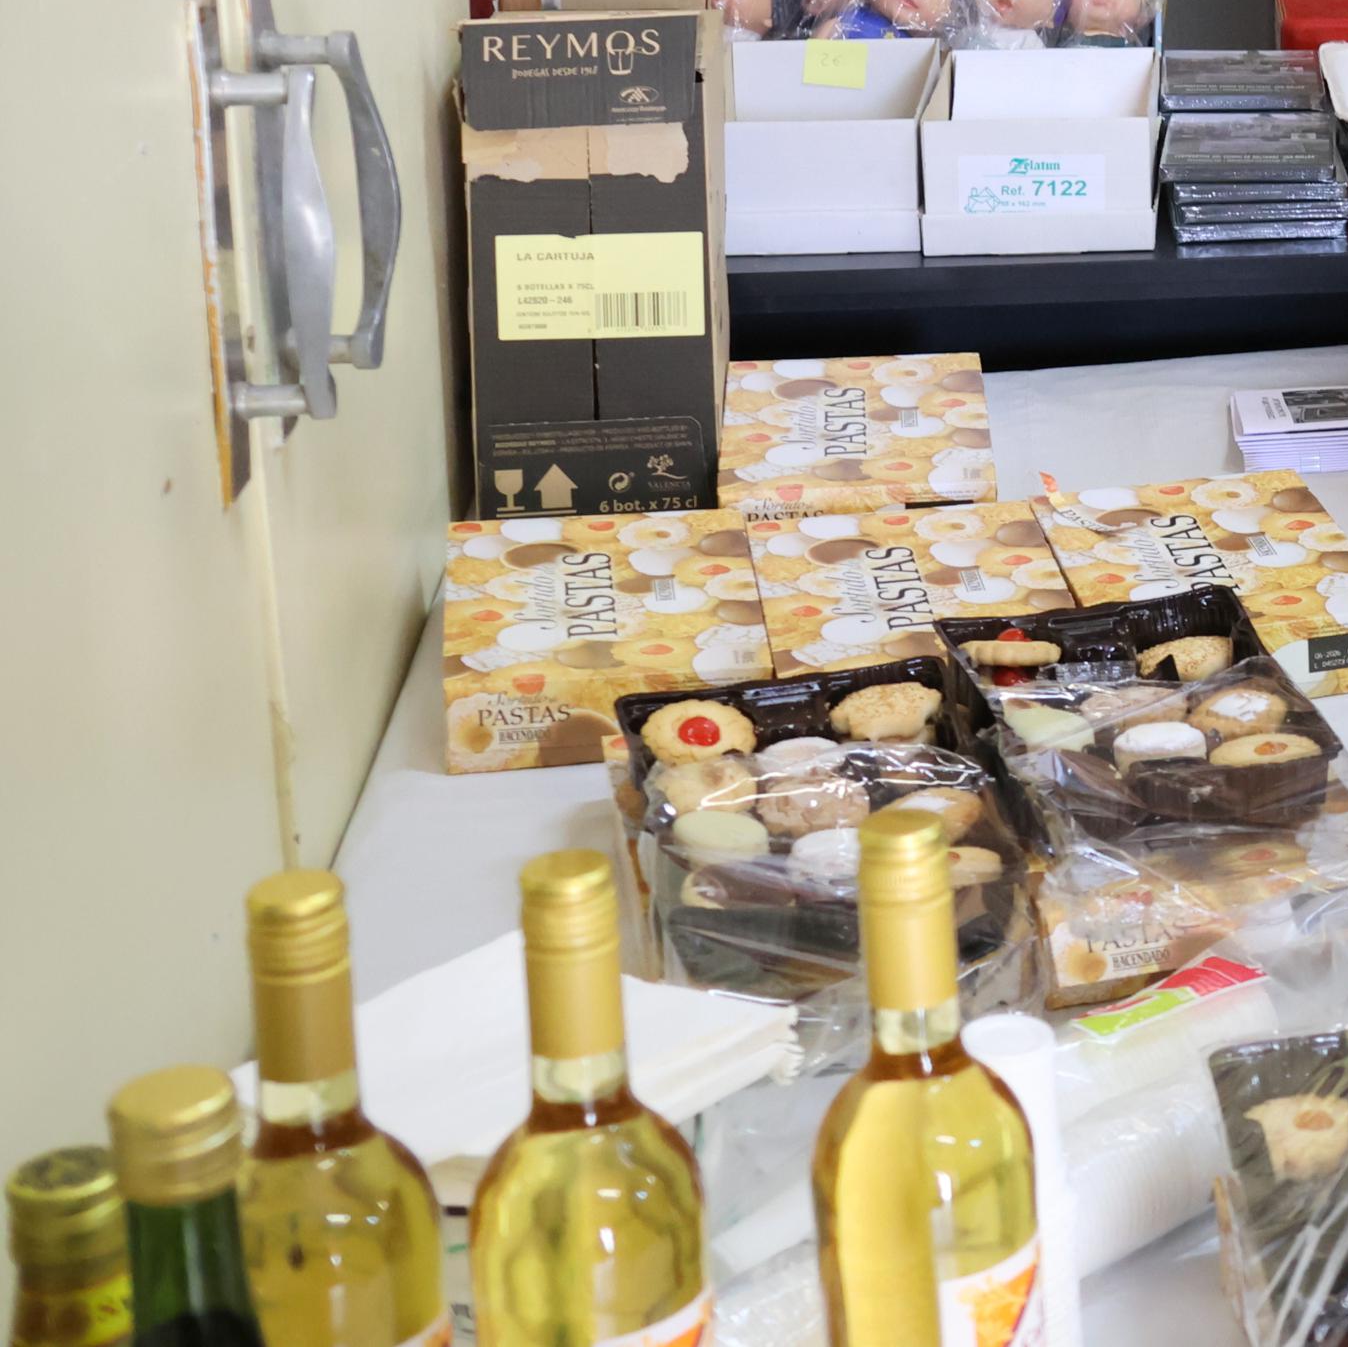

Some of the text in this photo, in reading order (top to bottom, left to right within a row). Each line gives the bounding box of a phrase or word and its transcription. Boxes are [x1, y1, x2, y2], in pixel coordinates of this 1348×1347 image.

[482, 28, 661, 63] REYMOS
[1000, 179, 1087, 197] Ref. 7122
[516, 251, 595, 262] LA CARTUJA
[823, 386, 868, 458] PASTAS
[599, 500, 610, 513] 6
[613, 498, 645, 512] bot.
[648, 499, 658, 510] x
[661, 497, 682, 510] 75
[562, 551, 617, 639] PASTAS
[865, 545, 936, 631] PASTAS
[477, 704, 571, 727] PASTAS
